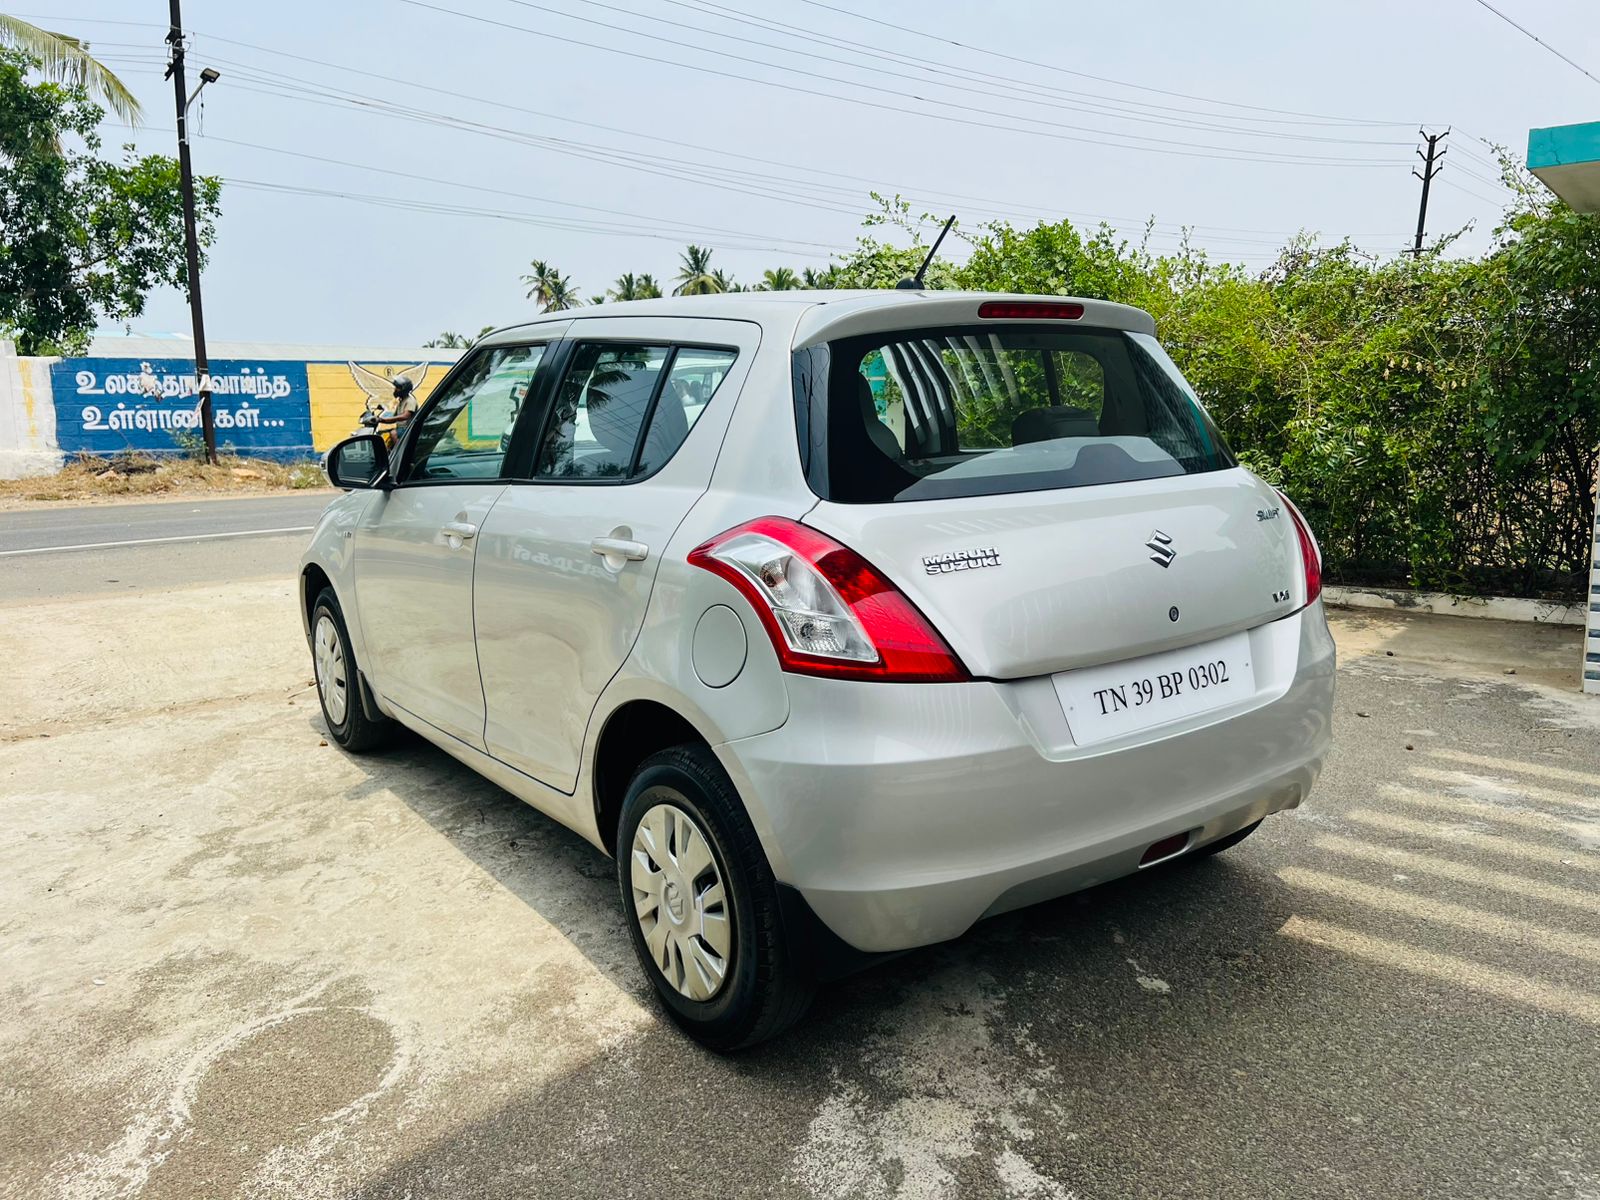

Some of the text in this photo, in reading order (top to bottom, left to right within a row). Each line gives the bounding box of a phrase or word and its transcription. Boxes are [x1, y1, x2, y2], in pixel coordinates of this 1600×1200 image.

[922, 547, 1000, 566] MARUTI
[926, 557, 1002, 576] SUZUKI
[1093, 660, 1229, 715] TN 39 BP 0302
